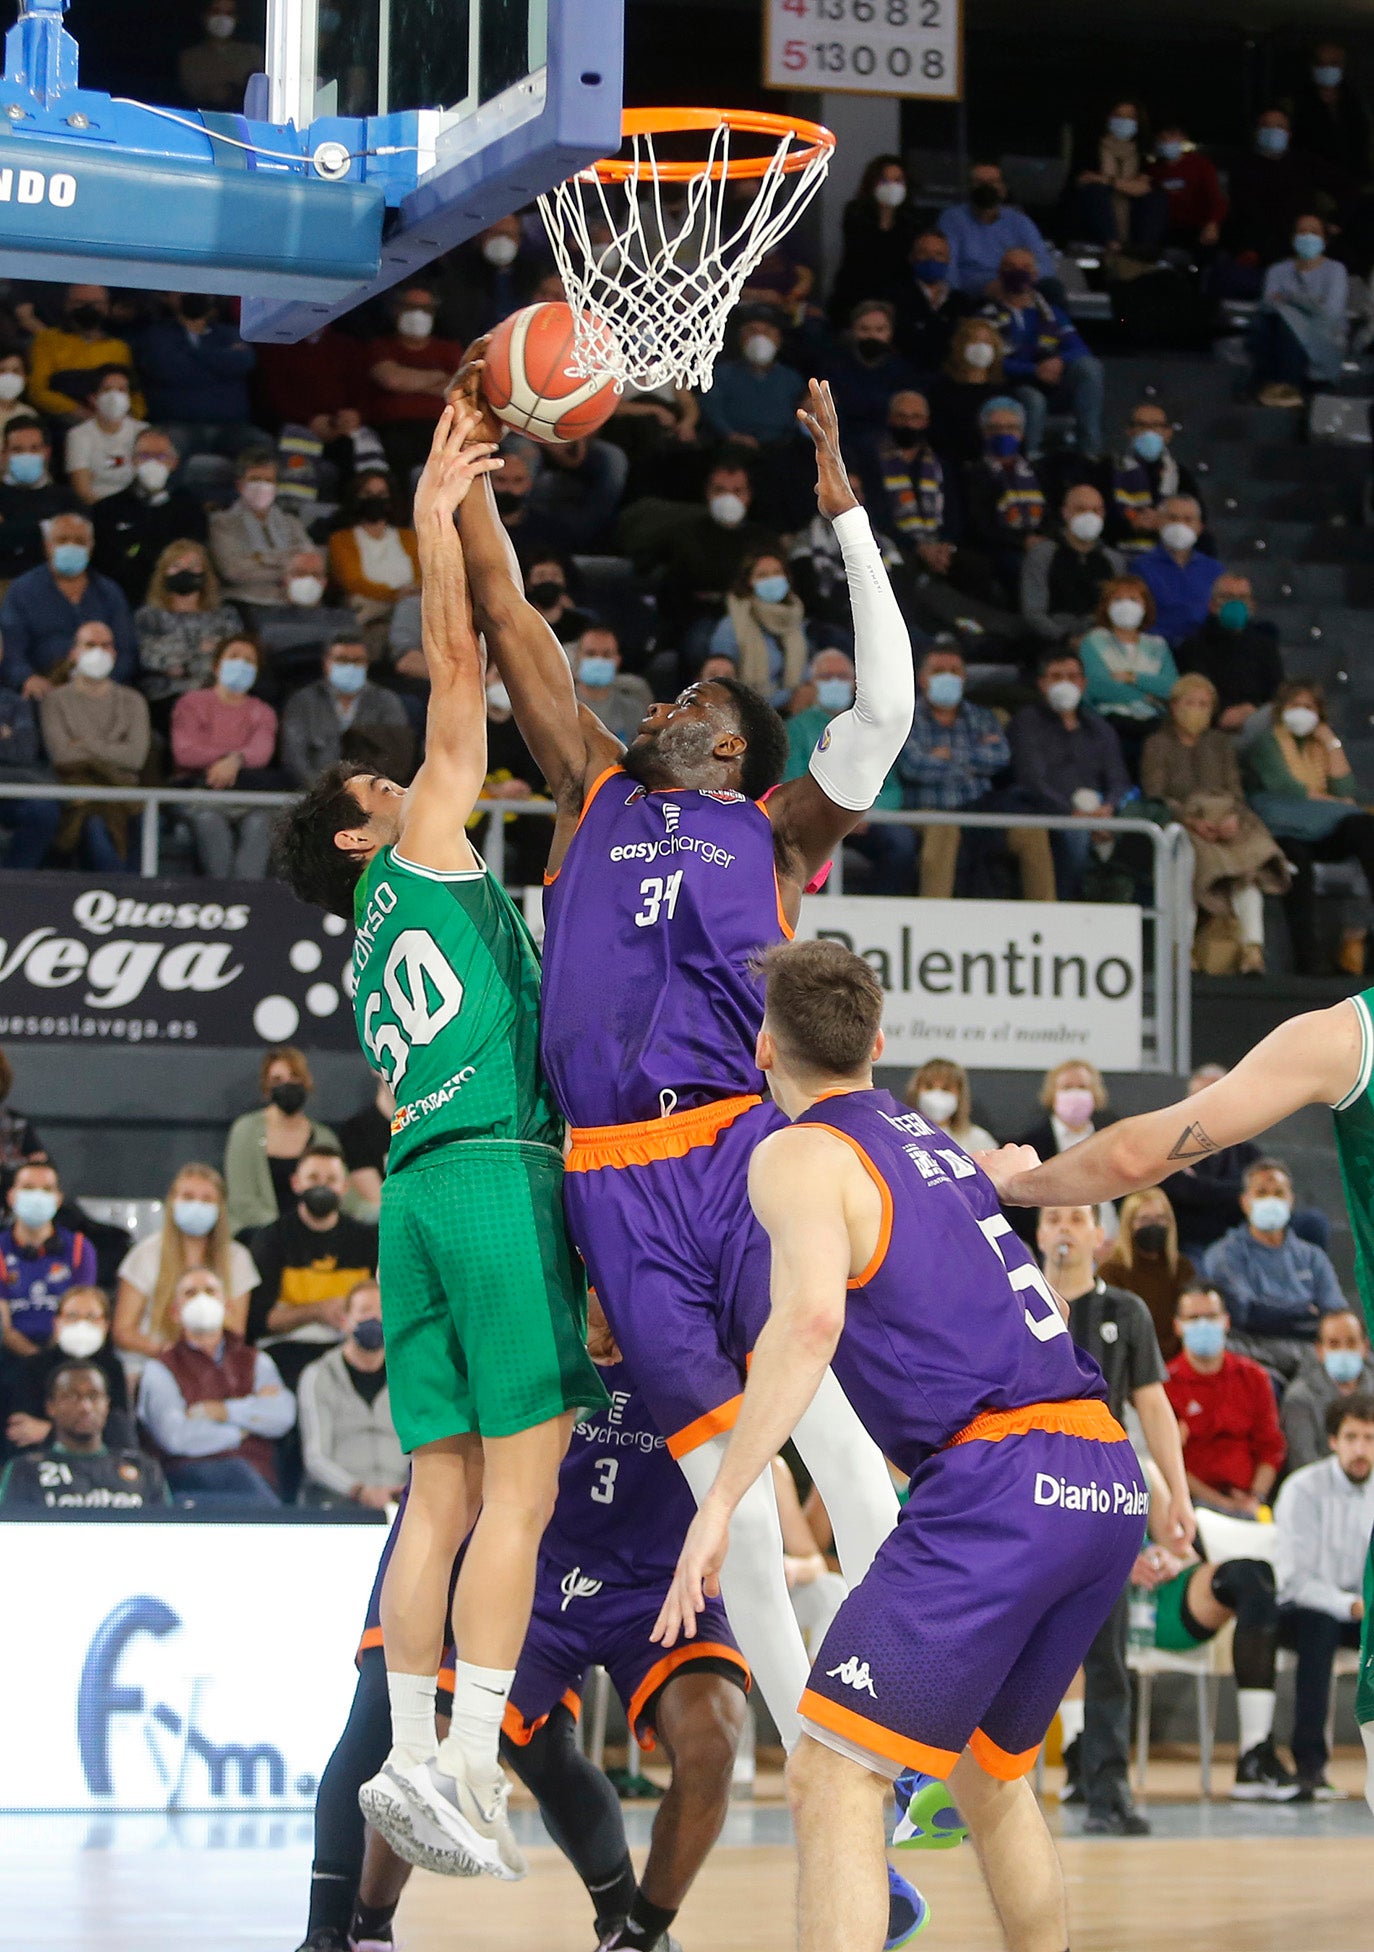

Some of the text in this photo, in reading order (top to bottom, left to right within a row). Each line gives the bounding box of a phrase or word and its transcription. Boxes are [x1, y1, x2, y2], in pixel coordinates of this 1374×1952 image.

[610, 835, 736, 869] easycharger
[72, 889, 250, 935] Quesos
[572, 1421, 667, 1453] sycharge
[590, 1457, 619, 1504] 3
[1034, 1472, 1111, 1514] Diario
